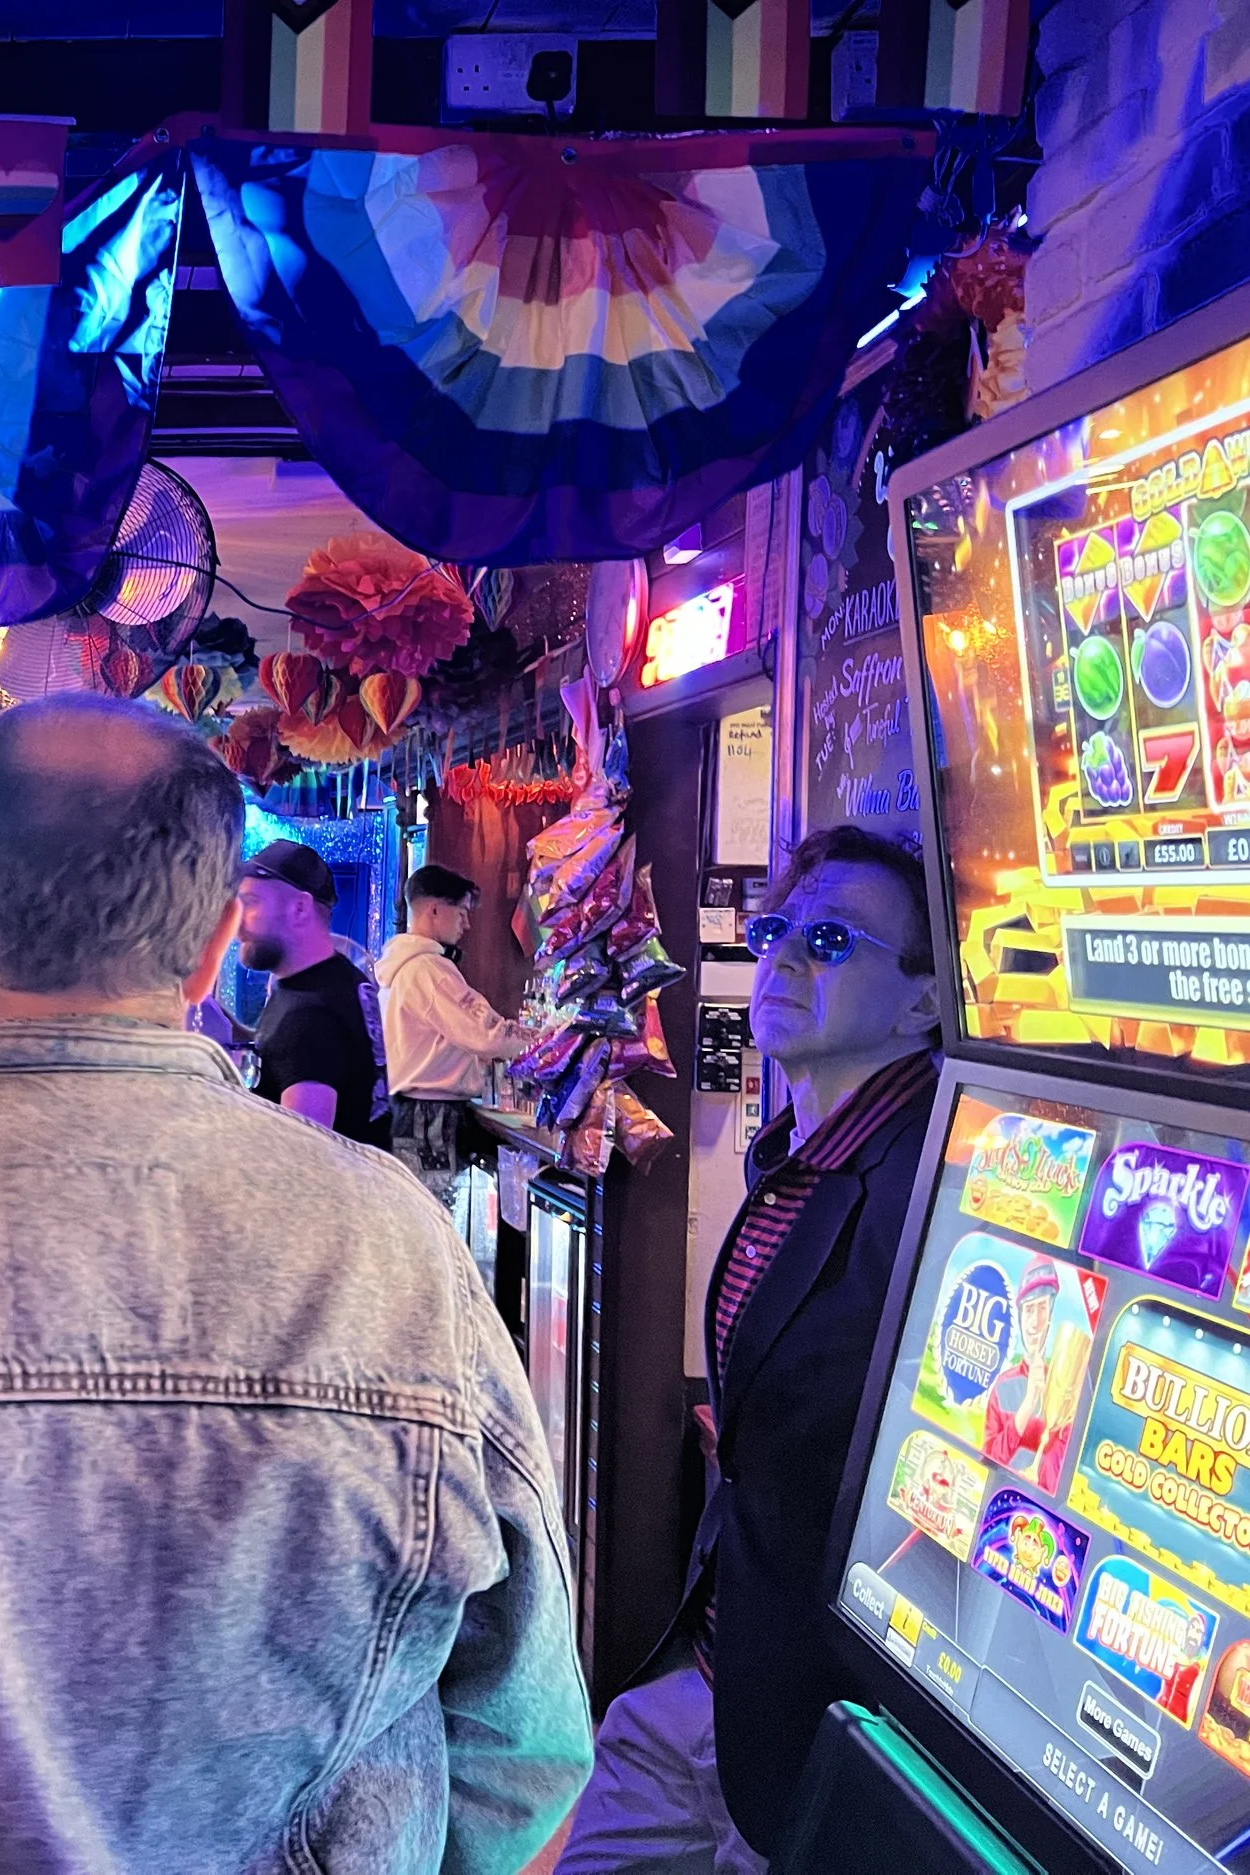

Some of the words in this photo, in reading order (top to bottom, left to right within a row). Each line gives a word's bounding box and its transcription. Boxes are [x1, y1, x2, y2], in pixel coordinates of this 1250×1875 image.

[1120, 538, 1185, 586] BONUS
[840, 652, 903, 708] Saffron
[1155, 843, 1195, 863] £55.00
[1085, 933, 1125, 964] Land
[1125, 935, 1139, 965] 3
[1141, 939, 1160, 966] or
[1162, 940, 1211, 969] more
[1169, 969, 1200, 1002] the
[1202, 971, 1244, 1006] free
[1103, 1150, 1227, 1232] Sparkle
[953, 1281, 1008, 1344] BIG
[941, 1350, 992, 1389] FORTUNE
[948, 1331, 997, 1367] HORSEY
[1120, 1354, 1250, 1452] BULLIO
[1097, 1443, 1149, 1490] GOLD
[1138, 1416, 1238, 1496] BARS
[853, 1578, 885, 1620] Collect
[1098, 1571, 1130, 1611] BIG
[1127, 1589, 1189, 1650] FISHING
[1086, 1602, 1179, 1681] FORTUNE
[937, 1651, 962, 1685] £0.00
[1083, 1694, 1113, 1731] More
[1112, 1716, 1153, 1763] Games
[1042, 1742, 1097, 1802] SELECT
[1097, 1791, 1110, 1819] A
[1113, 1806, 1163, 1866] GAME!
